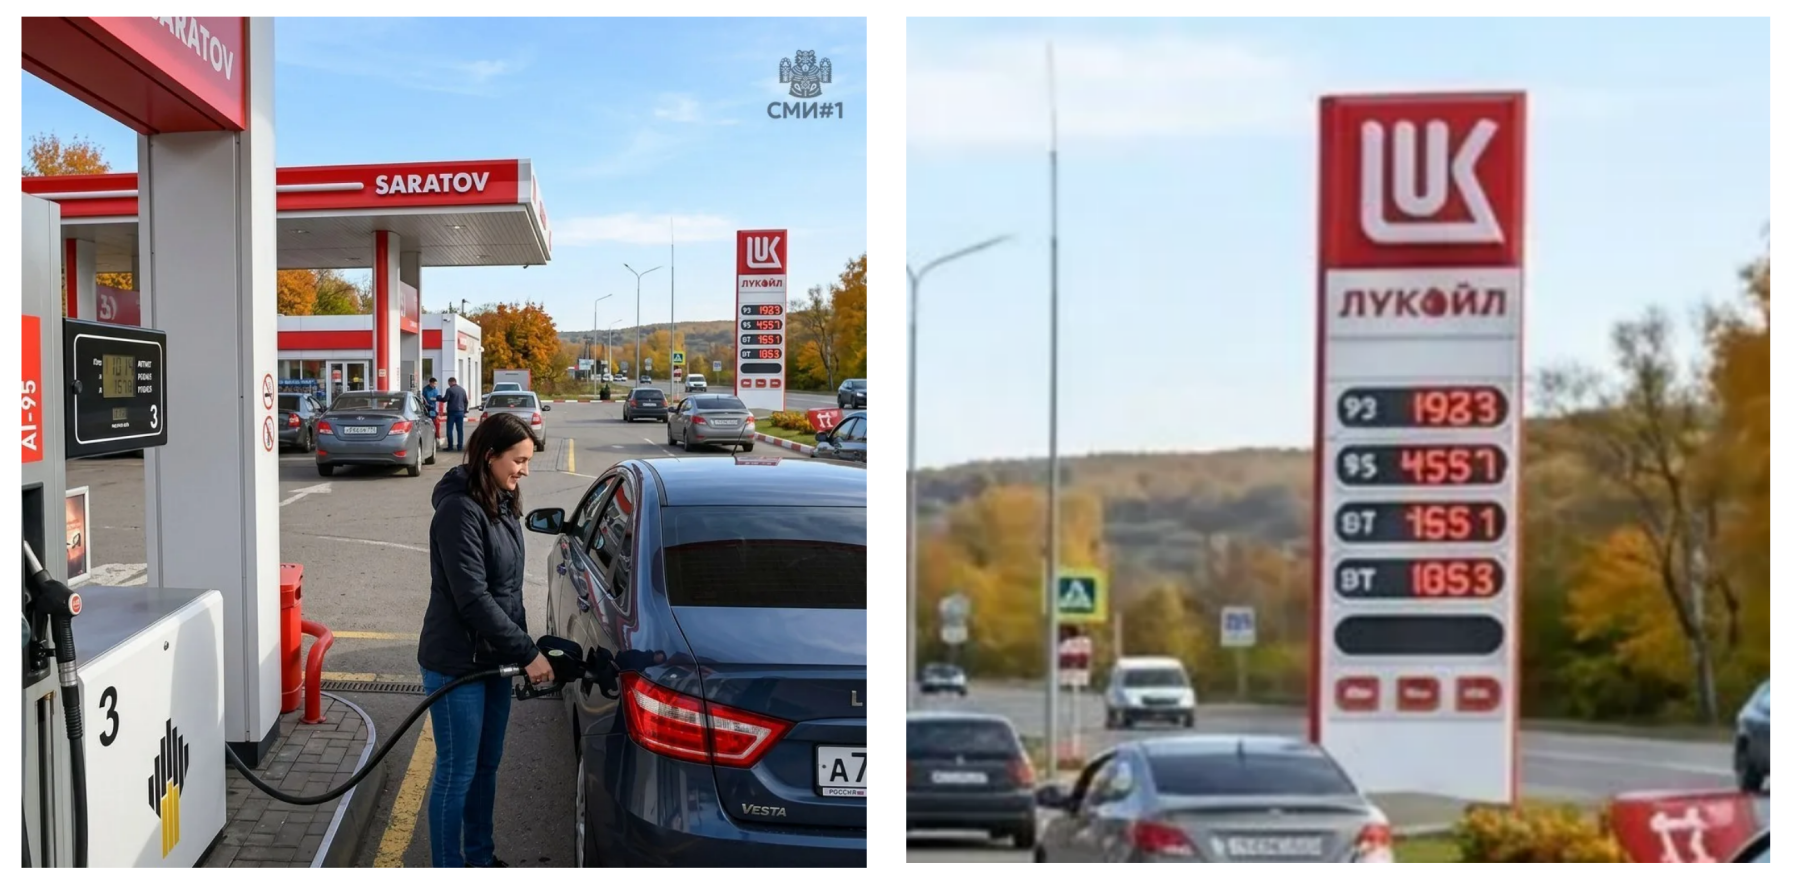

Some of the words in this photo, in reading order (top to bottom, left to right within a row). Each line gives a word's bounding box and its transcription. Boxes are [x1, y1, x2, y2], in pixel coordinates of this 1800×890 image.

[152, 16, 234, 80] ARATOV
[375, 172, 490, 195] SARATOV
[741, 278, 783, 288] ЛУКОЙЛ
[1338, 281, 1507, 318] ЛУКОЙЛ
[150, 404, 158, 429] 3
[1343, 394, 1377, 420] 93
[1343, 453, 1377, 479] 95
[851, 690, 863, 707] L
[99, 686, 119, 747] 3
[741, 803, 787, 817] VESTA
